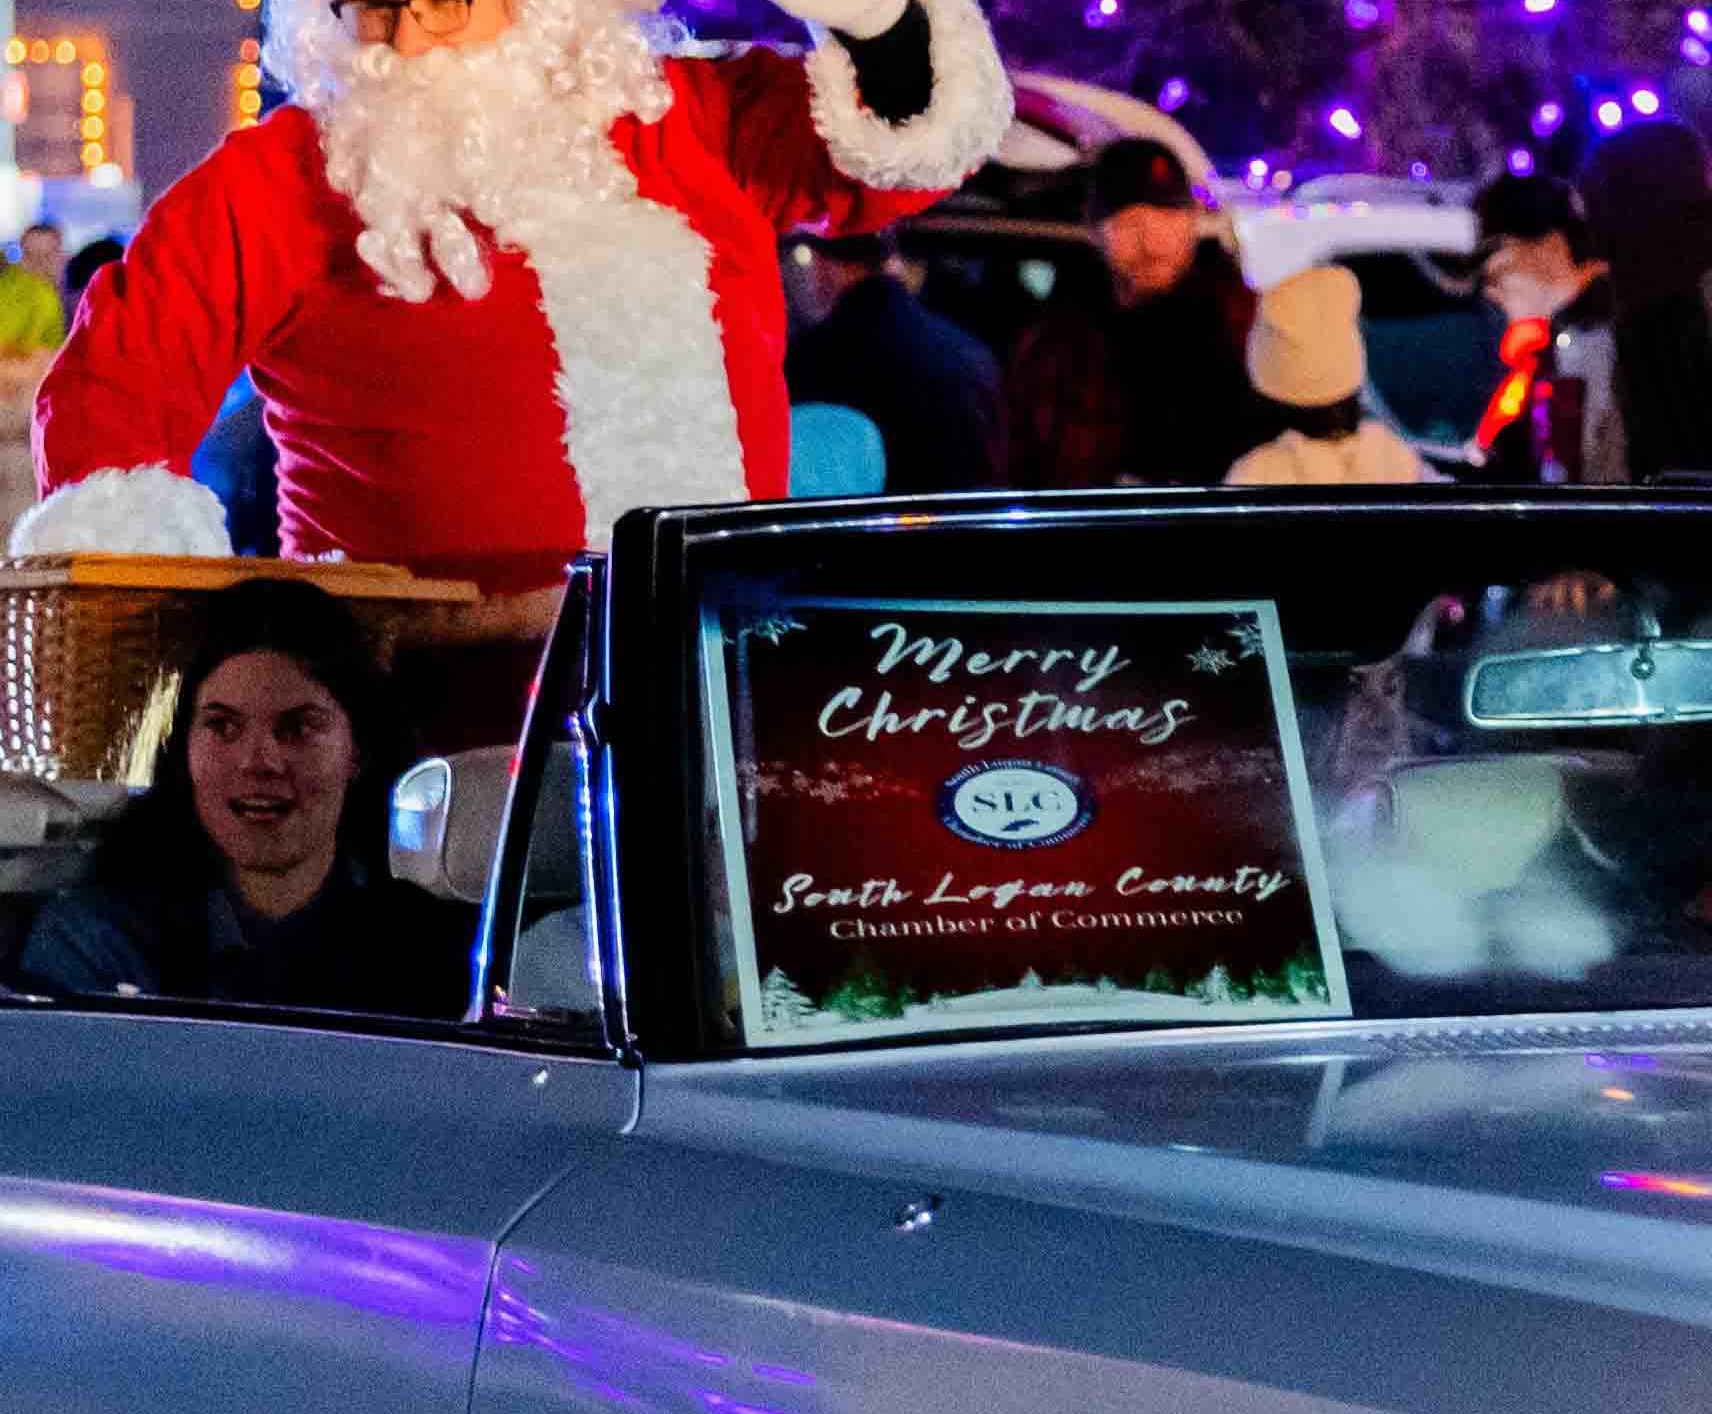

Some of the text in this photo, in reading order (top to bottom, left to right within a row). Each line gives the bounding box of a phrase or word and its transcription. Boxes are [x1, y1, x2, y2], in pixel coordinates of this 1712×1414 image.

[870, 622, 1131, 692] Merry
[818, 686, 1197, 750] Christmas
[972, 791, 1062, 813] SLC
[773, 865, 1291, 914] South Logan County
[829, 908, 1245, 941] Chamber of Commerce
